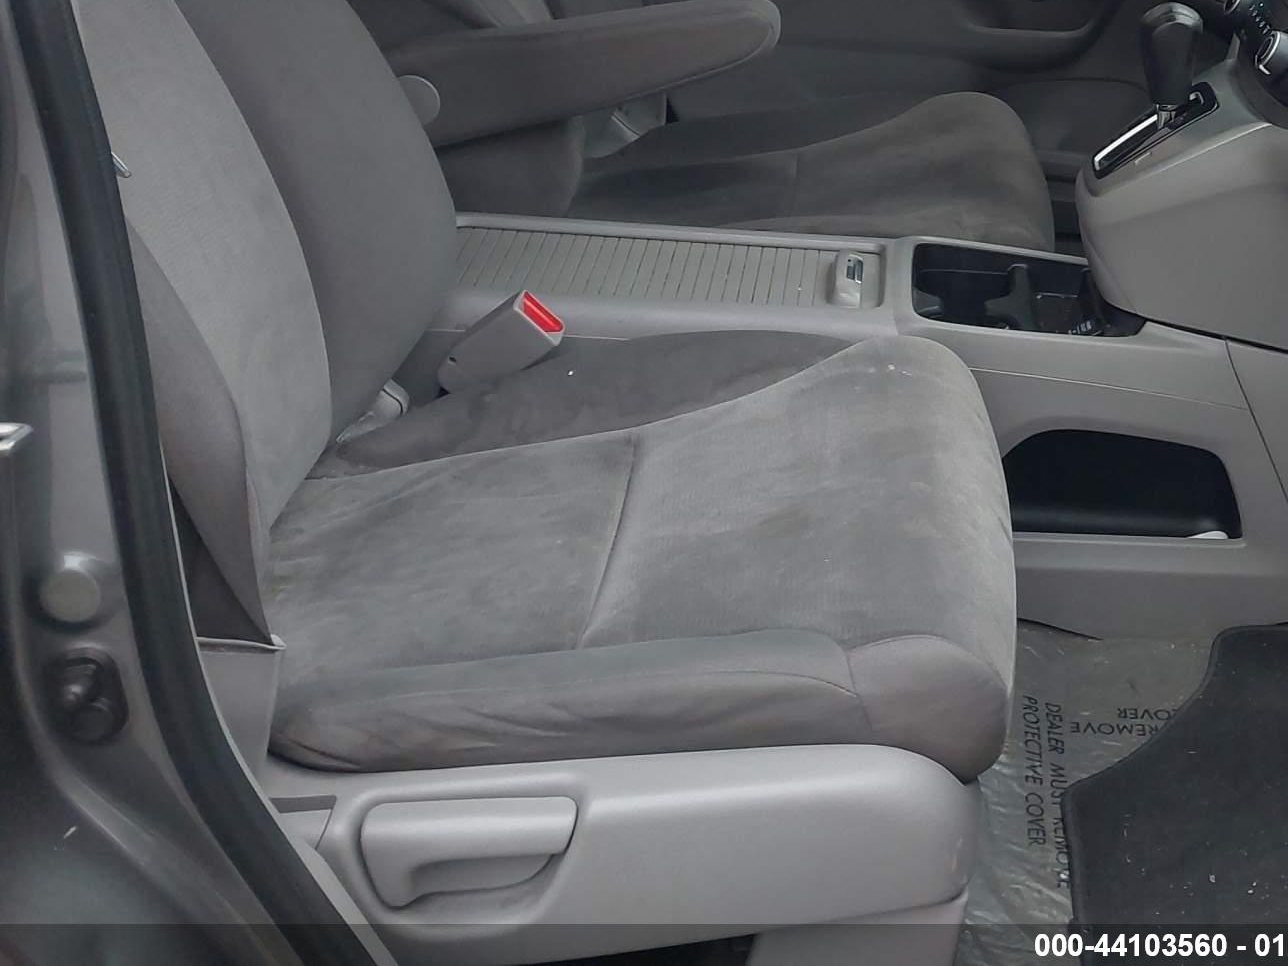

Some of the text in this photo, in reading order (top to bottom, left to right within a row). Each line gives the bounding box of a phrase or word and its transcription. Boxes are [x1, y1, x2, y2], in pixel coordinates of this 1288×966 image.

[1045, 702, 1065, 755] DEALER
[1117, 707, 1178, 721] OVER
[1022, 695, 1047, 846] PROTECTIVE COVER
